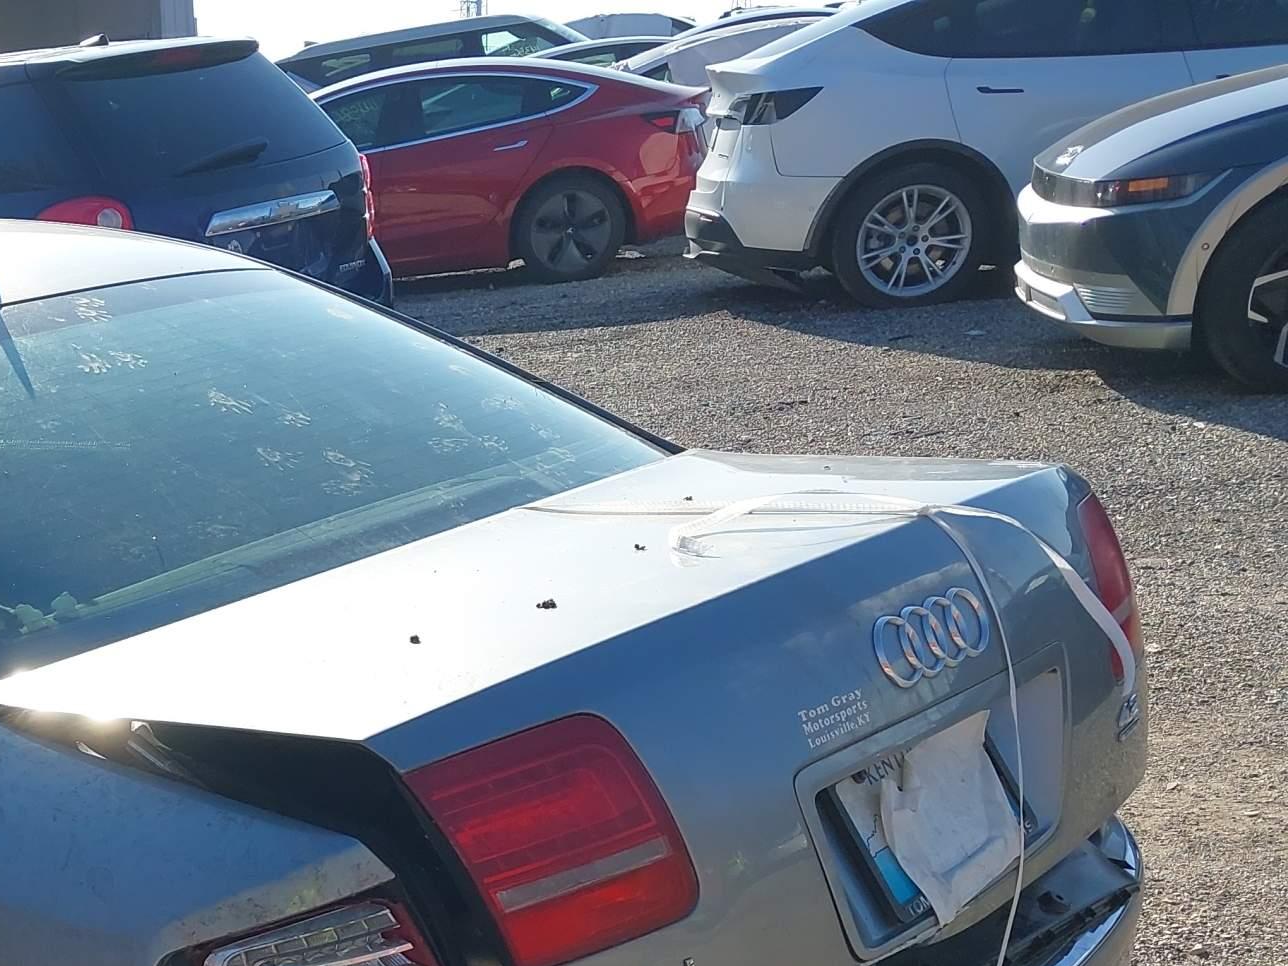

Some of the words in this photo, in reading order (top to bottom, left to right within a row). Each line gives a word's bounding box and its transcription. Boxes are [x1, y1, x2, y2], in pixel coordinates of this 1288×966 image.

[797, 703, 830, 722] Tom
[831, 688, 862, 707] Gray
[802, 700, 868, 736] Motorsports
